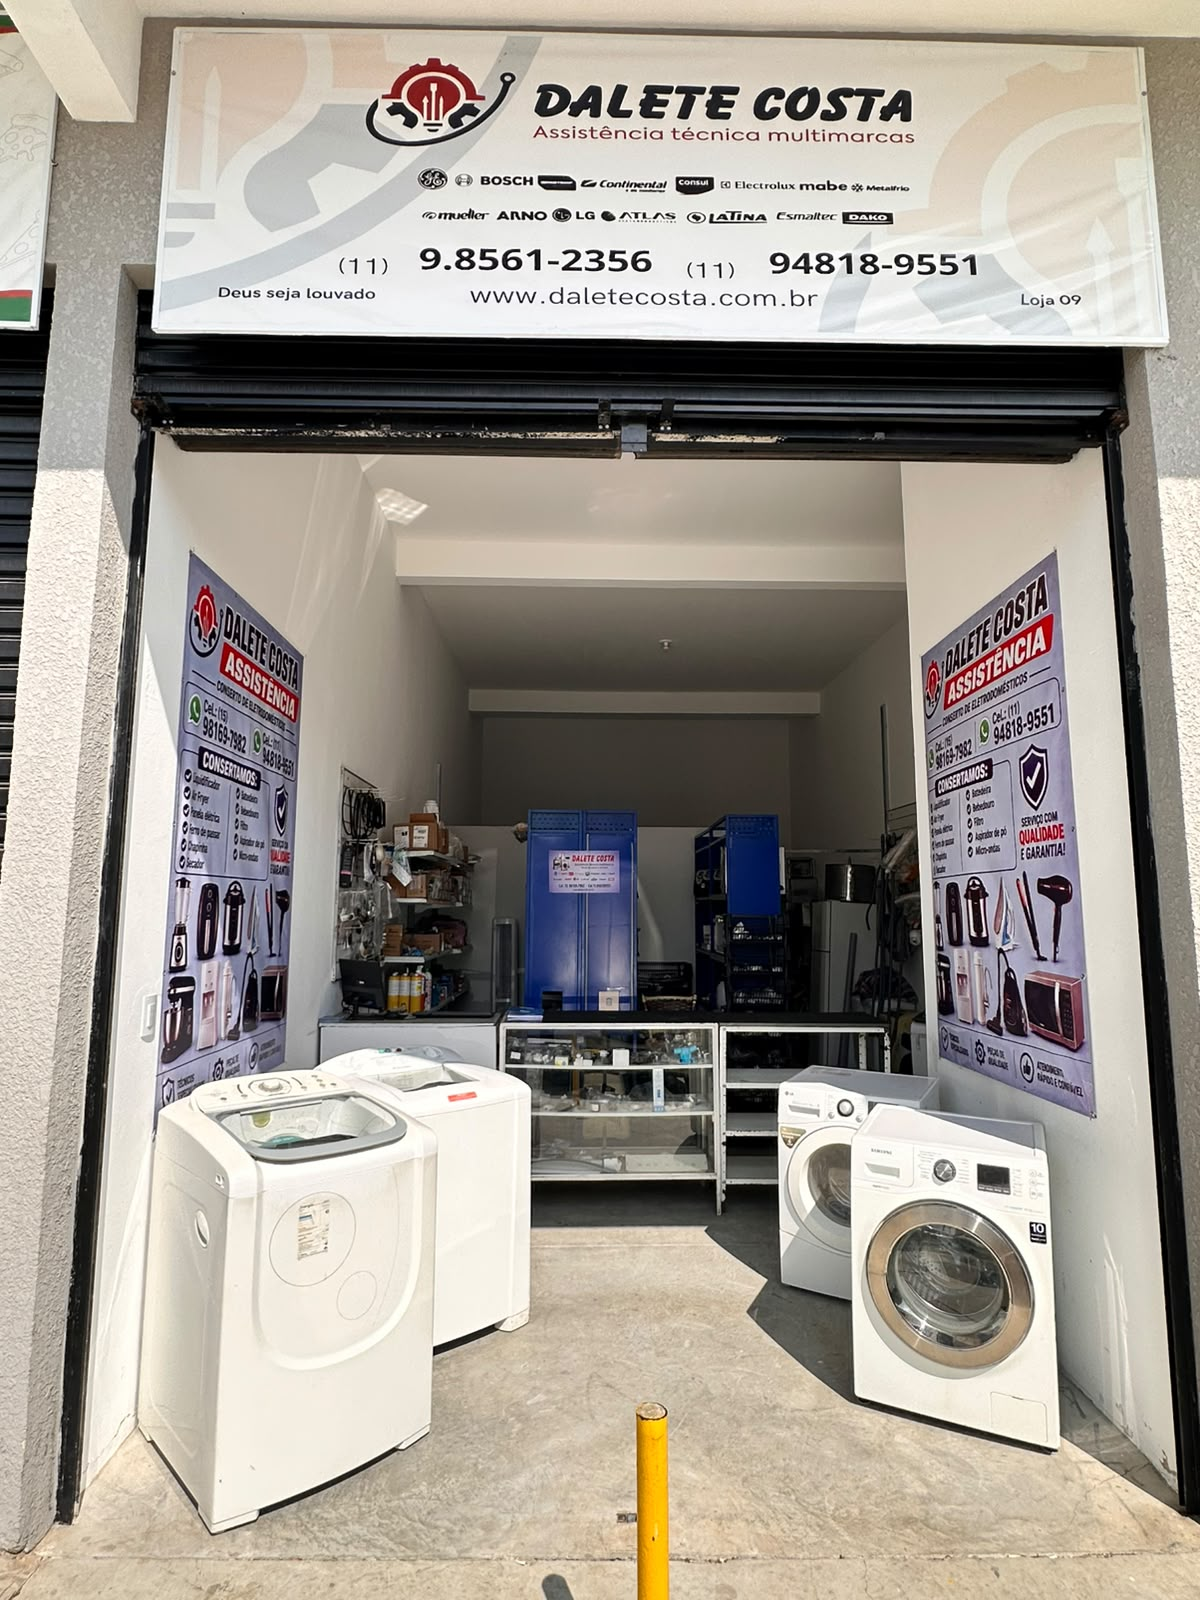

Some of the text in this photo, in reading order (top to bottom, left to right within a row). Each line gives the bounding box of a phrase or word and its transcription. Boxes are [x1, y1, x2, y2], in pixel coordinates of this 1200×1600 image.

[534, 83, 913, 122] DALETE COSTA
[533, 125, 915, 144] Assistência técnica multimarcas
[480, 176, 533, 186] BOSCH
[599, 180, 667, 190] Continental
[679, 179, 709, 187] Consul
[735, 181, 796, 191] Electrolux
[800, 180, 847, 191] mabe
[438, 208, 489, 220] mueller
[497, 211, 547, 220] ARNO
[576, 211, 595, 220] LG
[619, 212, 676, 220] ATLAS
[776, 211, 838, 221] Esmaltec
[849, 213, 887, 221] DAKO
[338, 247, 979, 280] (11) 9.8561-2356 (11) 94818-9551
[218, 286, 1081, 307] Deus seja louvado www.daletecosta.com.br Loja 09
[945, 574, 1047, 678] DALETE COSTA
[224, 606, 298, 691] DALETE COSTA
[947, 625, 1046, 705] ASSISTÊNCIA
[225, 652, 295, 720] ASSISTÊNCIA
[971, 672, 1028, 711] ELETRODOMÉSTICOS
[993, 703, 1055, 745] 94818-9551
[1008, 700, 1020, 718] (11)
[203, 717, 247, 754] 98169-7982
[203, 752, 258, 787] CONSERTAMOS:
[936, 738, 973, 770] 98169-7982
[937, 762, 989, 793] CONSERTAMOS:
[1019, 823, 1065, 846] QUALIDADE
[1022, 811, 1058, 828] SERVIÇO COM
[572, 855, 615, 863] DALETE COSTA
[1026, 843, 1066, 859] GARANTIA!
[1031, 1222, 1044, 1233] 10
